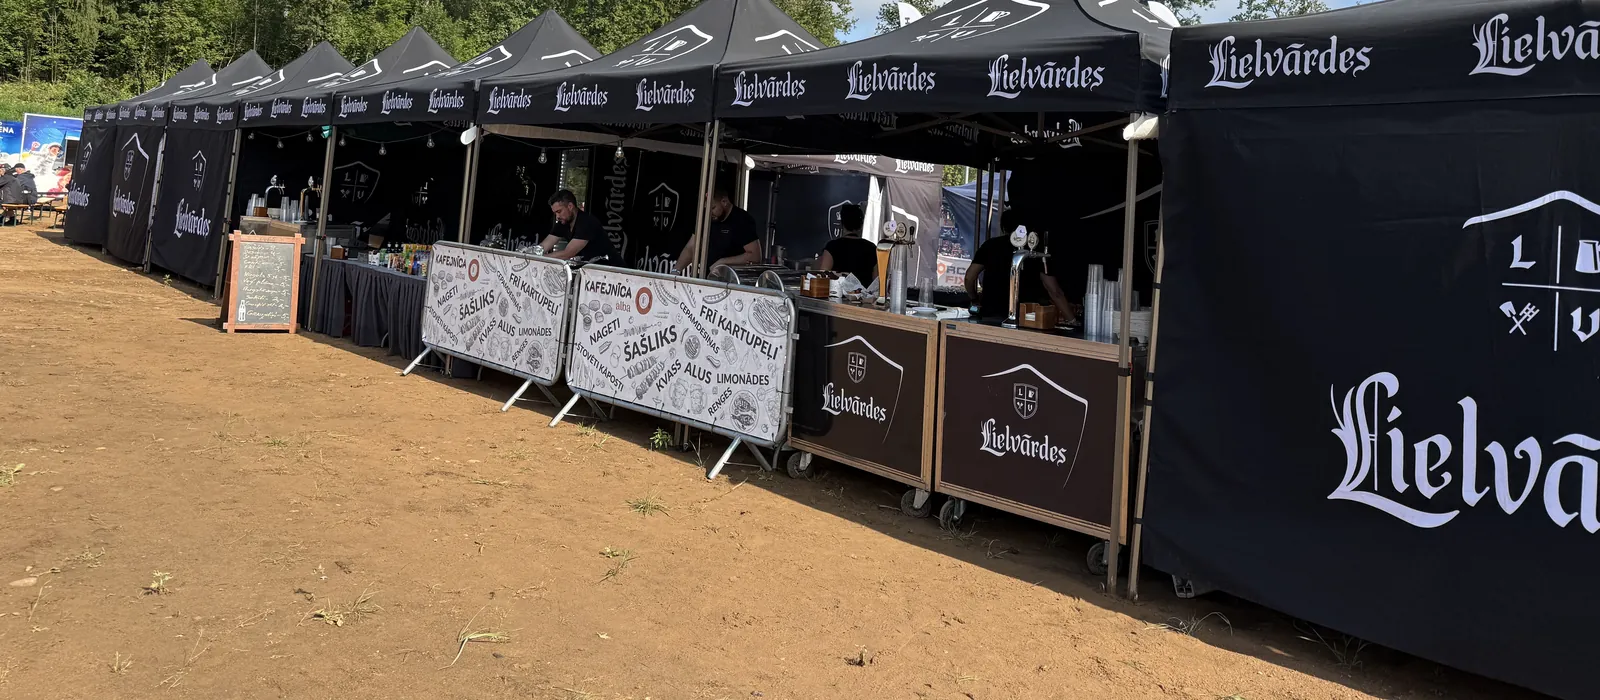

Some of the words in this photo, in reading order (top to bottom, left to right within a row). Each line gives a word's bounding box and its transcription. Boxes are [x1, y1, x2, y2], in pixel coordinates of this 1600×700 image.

[986, 53, 1106, 99] Lielvārdes
[1204, 35, 1374, 89] Lielvārdes
[553, 81, 609, 112] Lielvārdes
[635, 77, 696, 112] Lielvārdes
[731, 70, 806, 107] Lielvārdes
[844, 60, 937, 101] Lielvārdes
[486, 86, 533, 115] Lielvārdes
[1509, 234, 1537, 270] L
[459, 289, 495, 321] ŠAŠLIKS
[585, 280, 632, 299] KAFEJNĪCA
[479, 317, 497, 345] KVASS
[497, 319, 516, 338] ALUS
[518, 325, 552, 337] LIMONĀDES
[589, 318, 621, 346] NAGETI
[623, 324, 678, 362] ŠAŠLIKS
[699, 304, 718, 325] FRĪ
[717, 315, 779, 360] KARTUPEĻI
[655, 358, 682, 392] KVASS
[683, 361, 712, 385] ALUS
[716, 372, 770, 386] LIMONĀDES
[821, 382, 886, 425] Lielvārdes
[979, 418, 1067, 467] Lielvārdes
